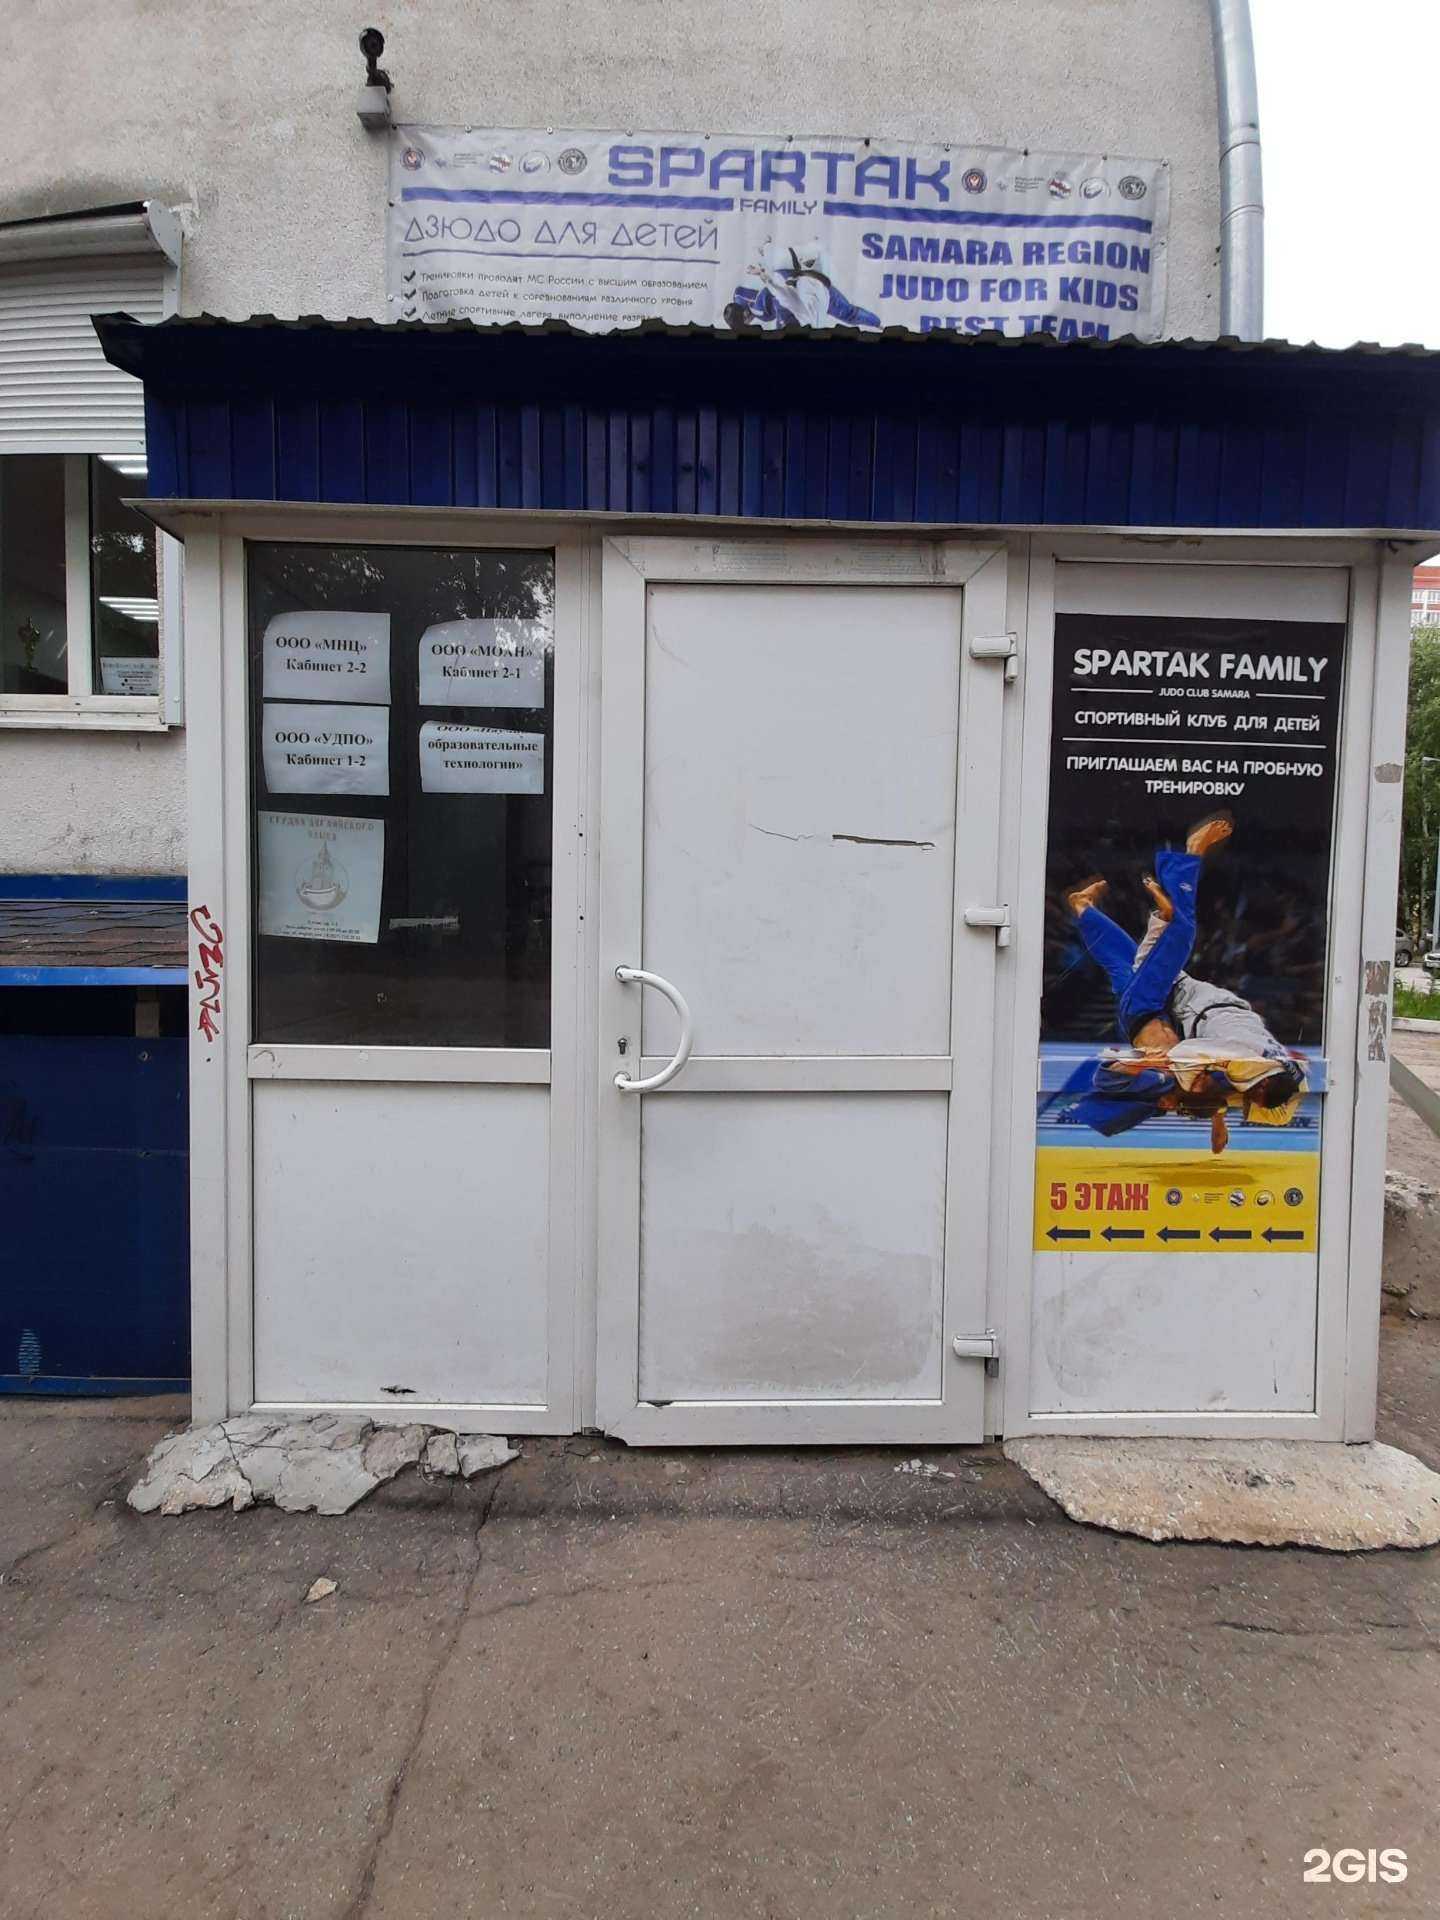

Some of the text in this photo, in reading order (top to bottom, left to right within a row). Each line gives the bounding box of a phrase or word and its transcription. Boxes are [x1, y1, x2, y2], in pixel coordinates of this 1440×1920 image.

[608, 145, 950, 202] SPARTAK
[740, 199, 817, 215] FAMILY
[862, 232, 1150, 274] SAMARA REGION
[528, 274, 544, 284] МС
[548, 275, 585, 286] России
[879, 274, 1139, 312] JUDO FOR KIDS
[275, 636, 311, 650] ООО
[431, 644, 466, 656] ООО
[286, 659, 367, 674] Кабинет 2-2
[442, 666, 521, 679] Кабинет 2-1
[1073, 649, 1328, 682] SPARTAK FAMILY
[1159, 687, 1250, 699] JUDO CLUB SAMARA
[1075, 710, 1320, 732] СПОРТИВНЫЙ КЛУБ ДЛЯ ДЕТЕЙ
[275, 732, 373, 746] ООО «УДПО»
[428, 738, 538, 752] образовательные
[286, 754, 366, 767] Кабинет 1-2
[1066, 756, 1323, 777] ПРИГЛАШАЕМ ВАС НА ПРОБНУЮ
[1145, 780, 1245, 795] ТРЕНИРОВКУ
[1050, 1182, 1149, 1211] 5 ЭТАЖ
